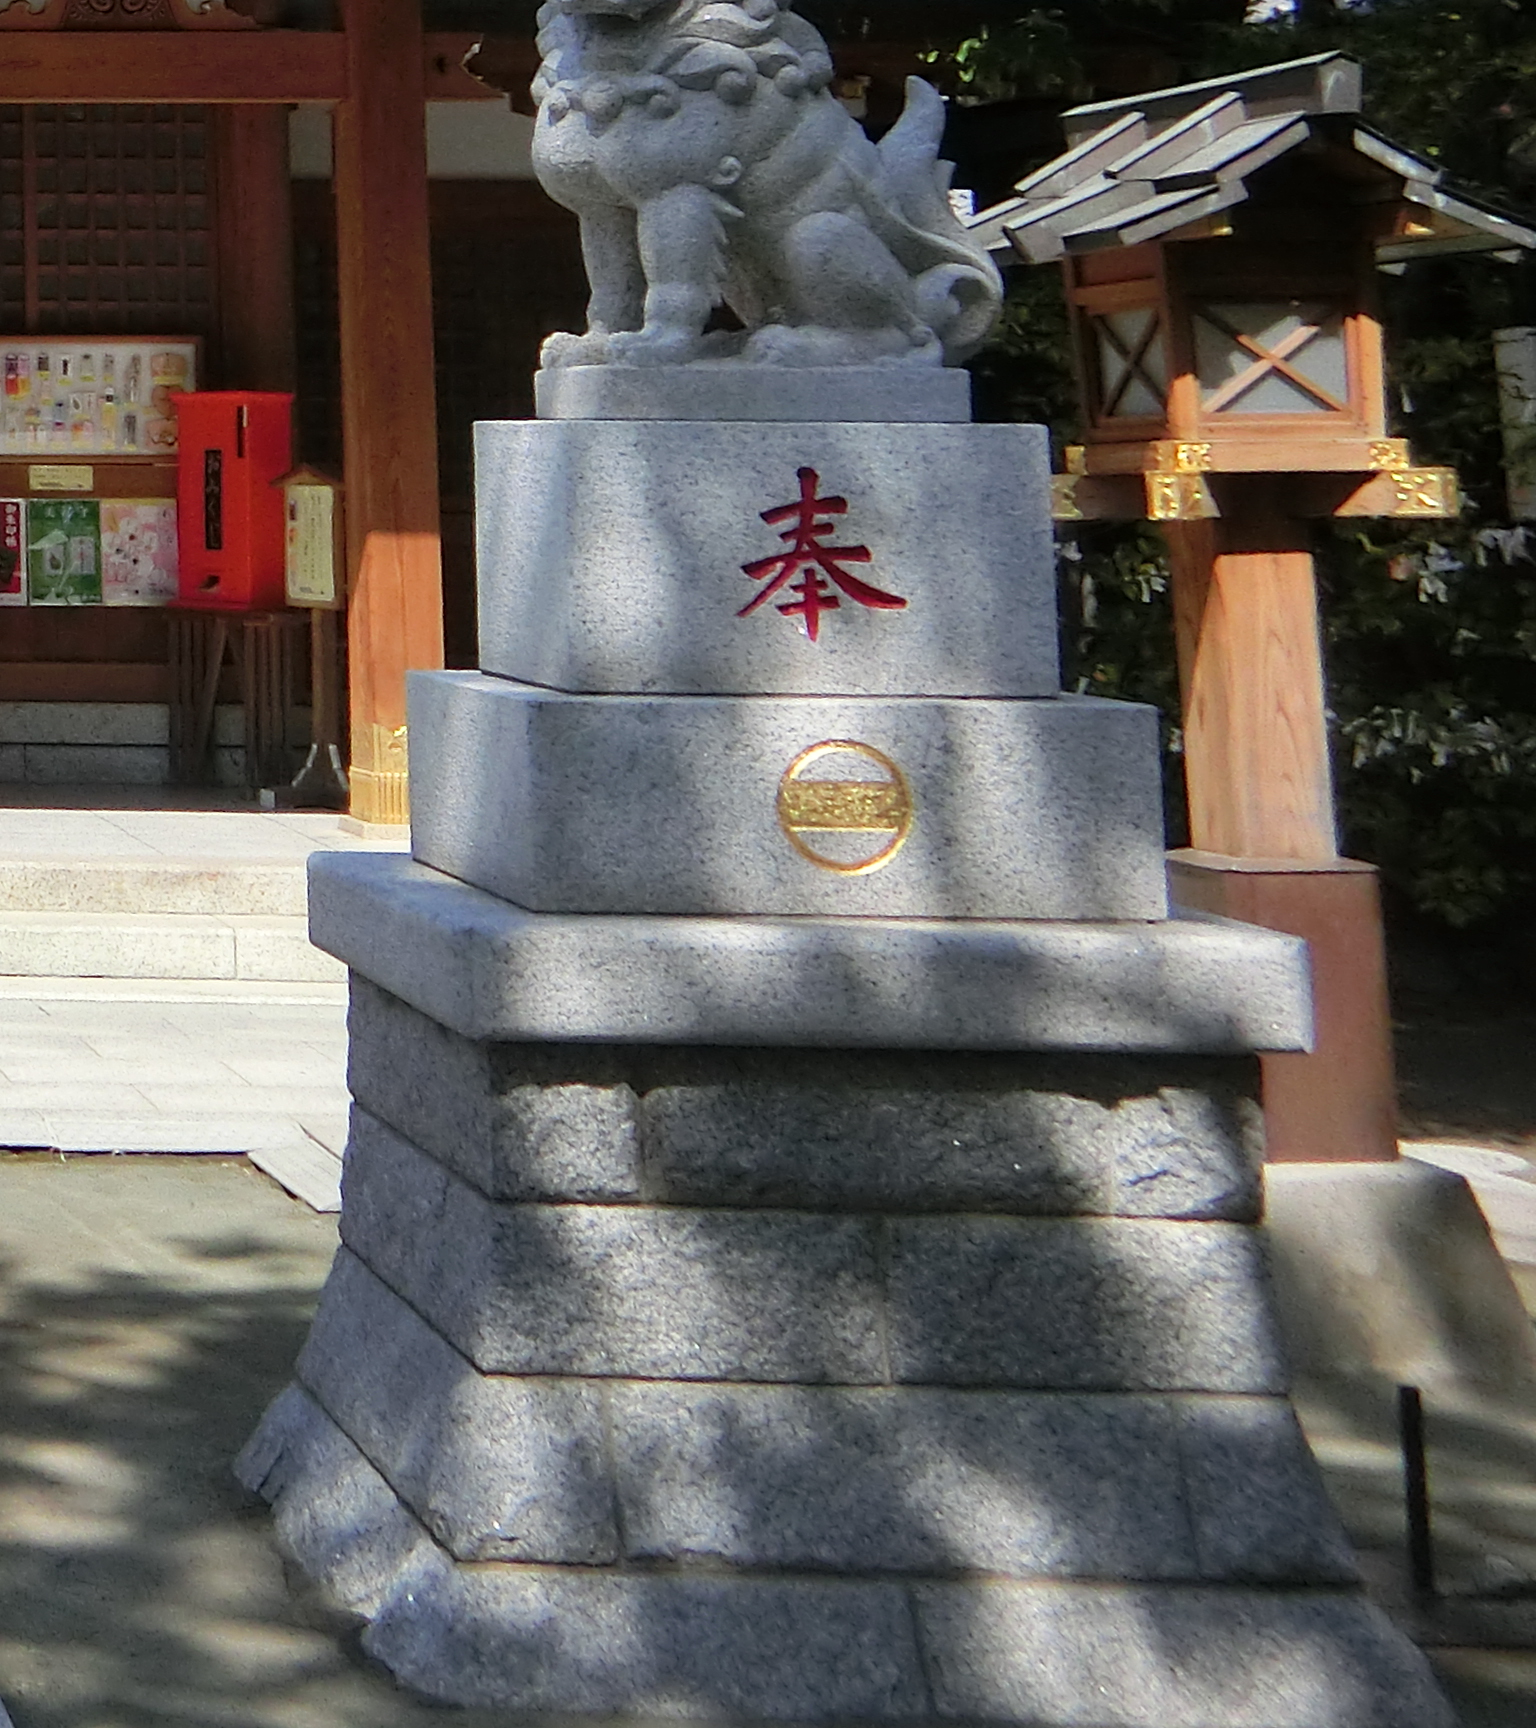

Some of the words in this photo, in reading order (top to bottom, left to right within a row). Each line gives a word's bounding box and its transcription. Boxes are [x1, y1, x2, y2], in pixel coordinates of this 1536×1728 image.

[206, 451, 222, 549] おみくじ
[736, 466, 909, 643] 奉
